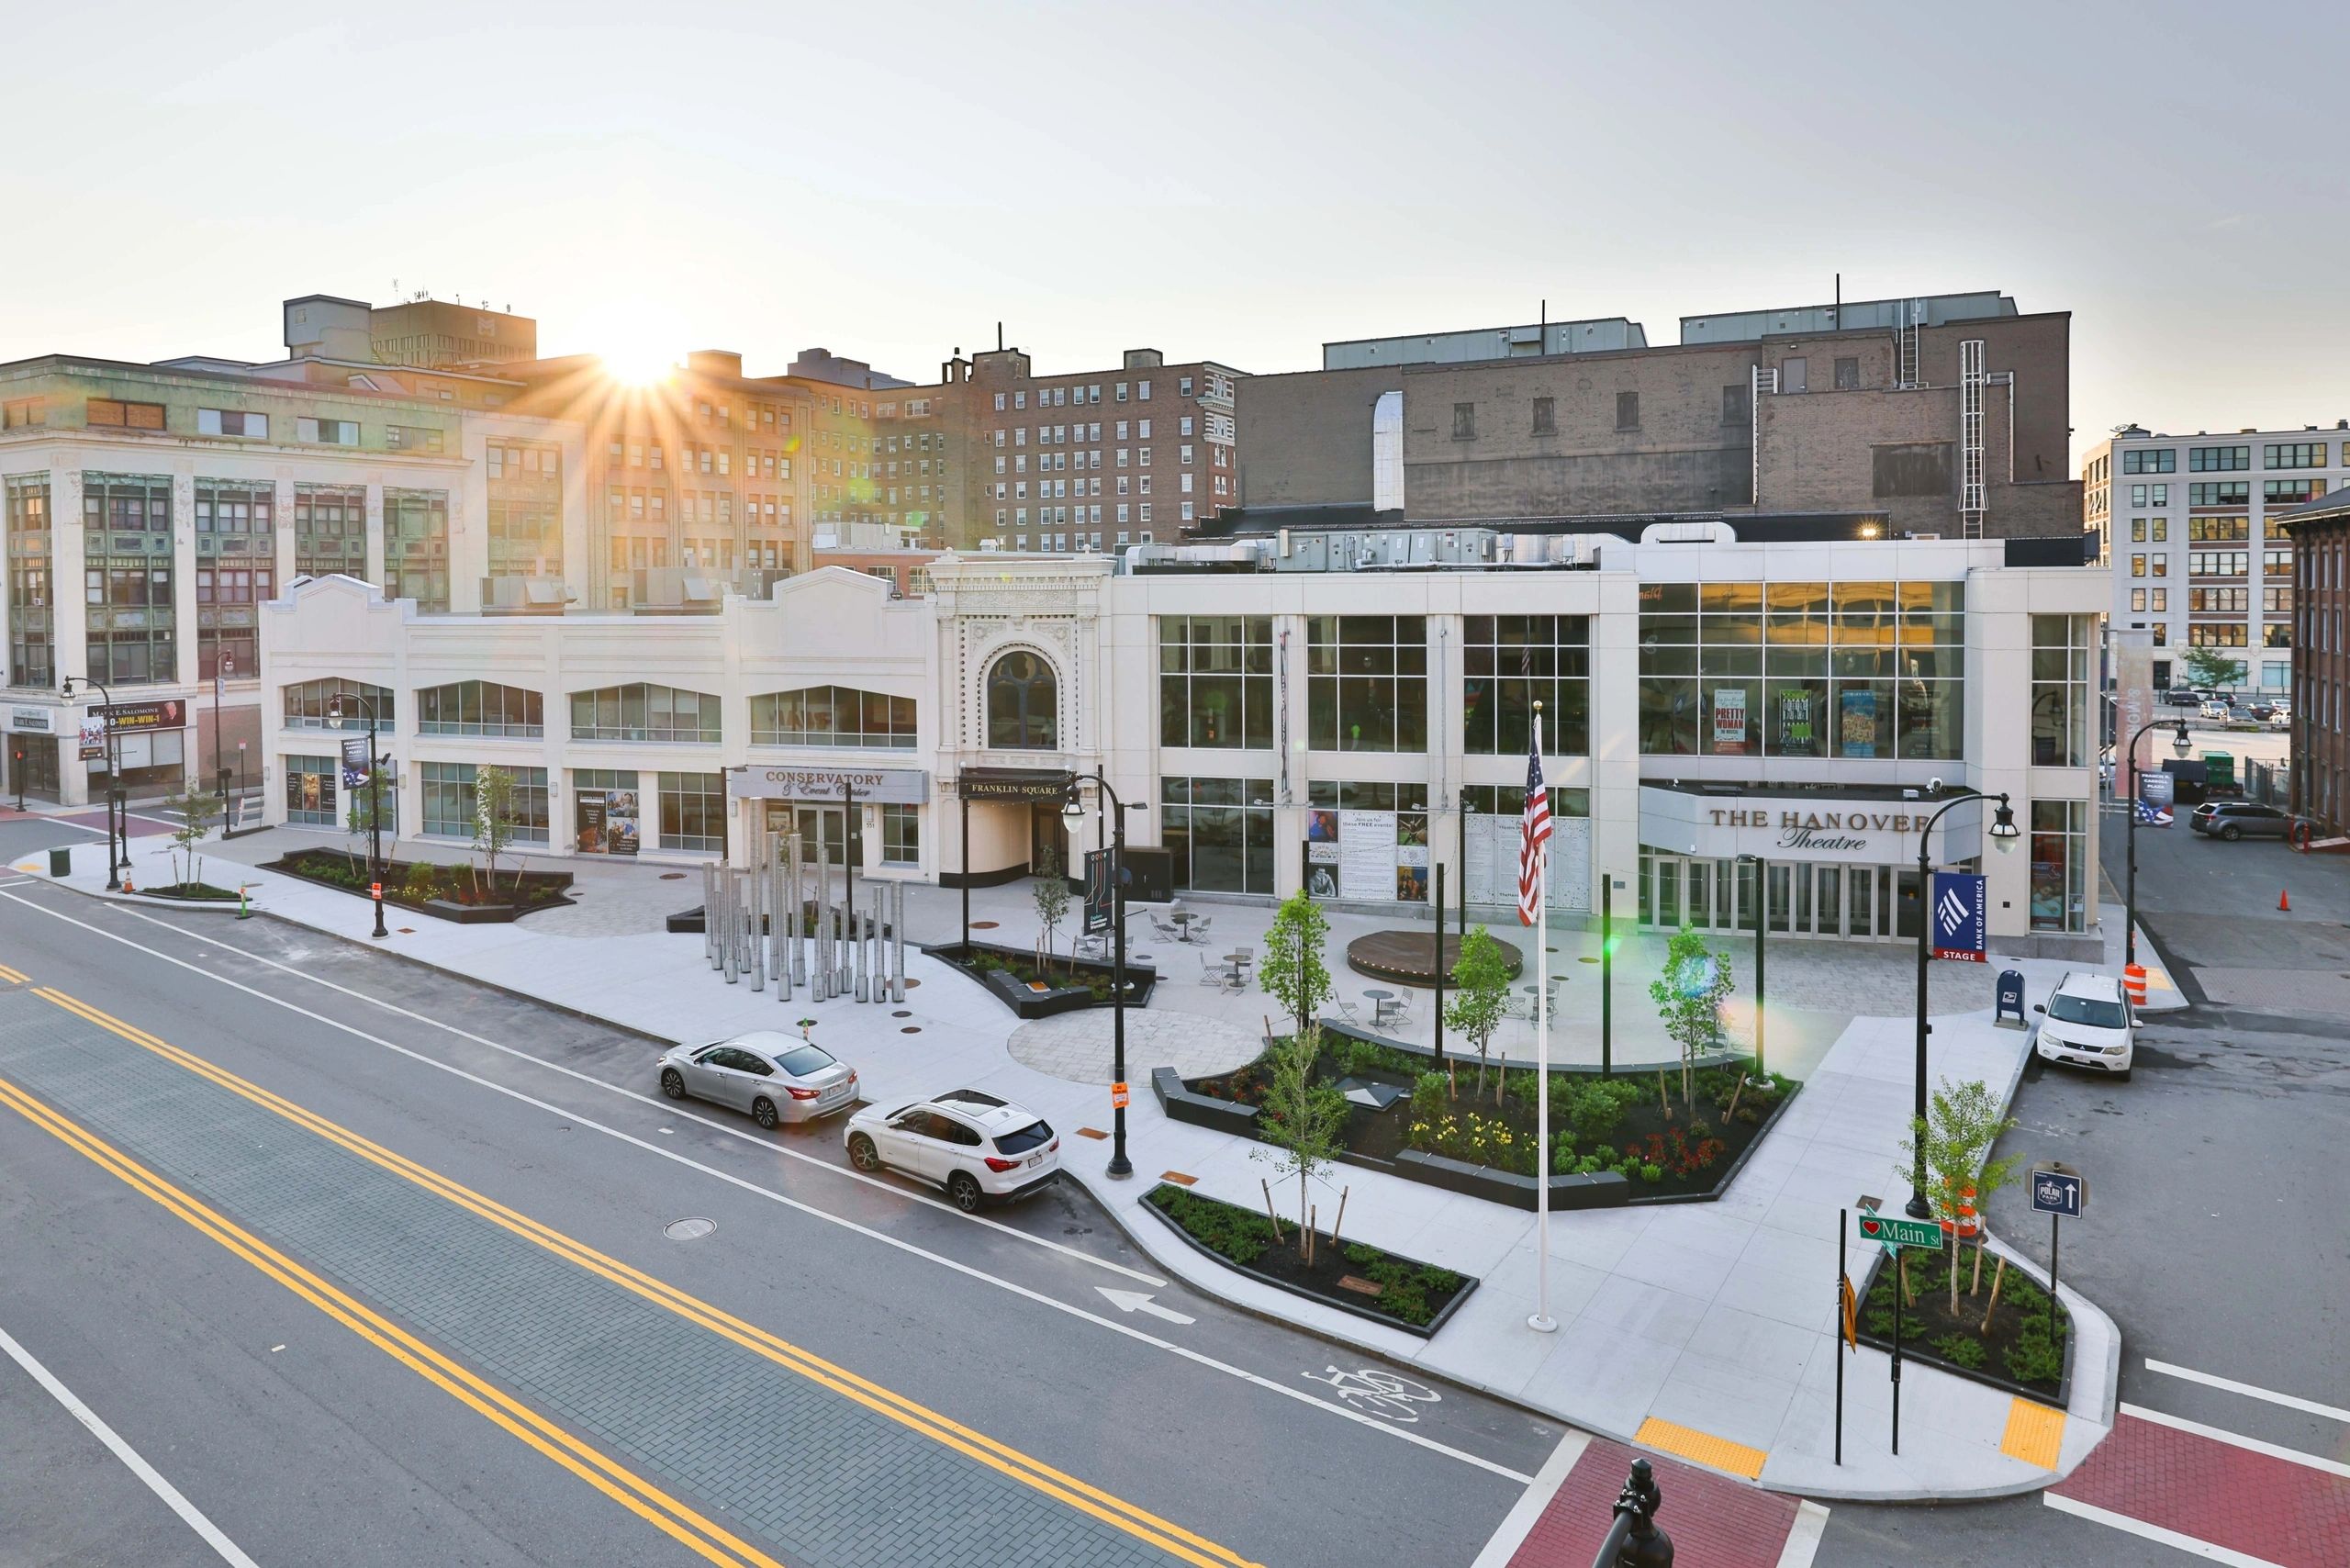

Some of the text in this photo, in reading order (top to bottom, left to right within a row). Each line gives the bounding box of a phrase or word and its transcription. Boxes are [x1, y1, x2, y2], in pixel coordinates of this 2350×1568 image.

[122, 707, 160, 715] SALOMONE
[1715, 708, 1745, 720] PRETTY
[1716, 719, 1744, 730] WOMAN
[766, 771, 884, 786] CONSERVATORY
[796, 781, 831, 796] Event
[972, 784, 1058, 796] FRANKLIN SQUARE
[1709, 809, 1933, 834] THE HANOVER
[1777, 825, 1867, 851] Theatre
[1975, 915, 1983, 927] OF
[1943, 950, 1975, 961] STAGE
[2040, 1185, 2060, 1198] POLAR
[1881, 1221, 1940, 1246] Main St
